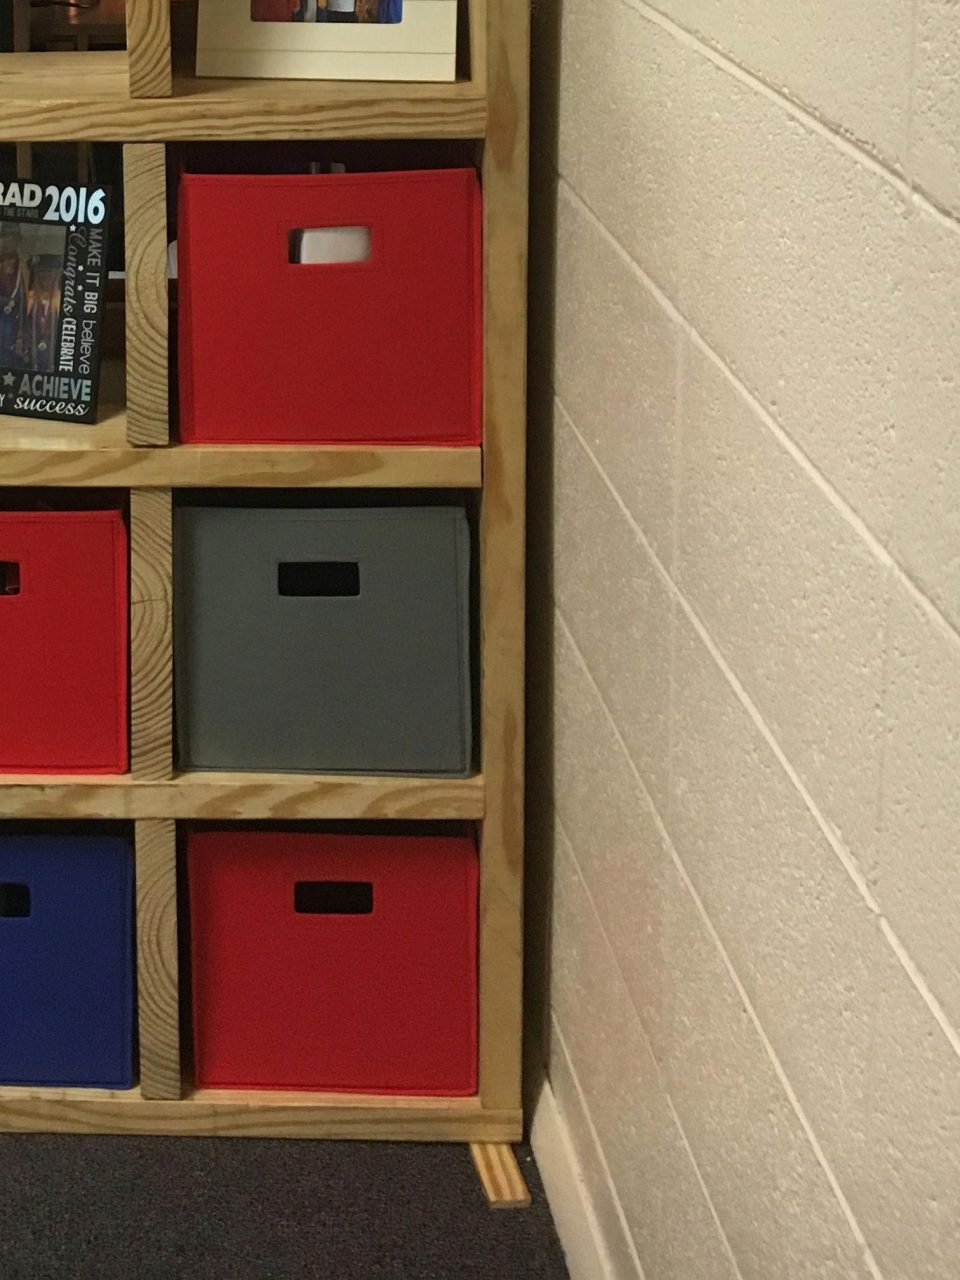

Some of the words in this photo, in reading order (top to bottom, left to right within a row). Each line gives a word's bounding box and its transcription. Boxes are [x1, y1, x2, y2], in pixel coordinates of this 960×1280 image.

[3, 207, 15, 216] THE
[42, 185, 106, 224] 2016
[87, 228, 103, 267] MAKE
[63, 226, 87, 316] Congrats
[85, 272, 100, 287] IT
[84, 291, 99, 314] BIG
[59, 317, 77, 372] CELEBRATE
[78, 320, 96, 375] believe
[18, 374, 92, 402] ACHIEVE
[14, 396, 90, 416] success
